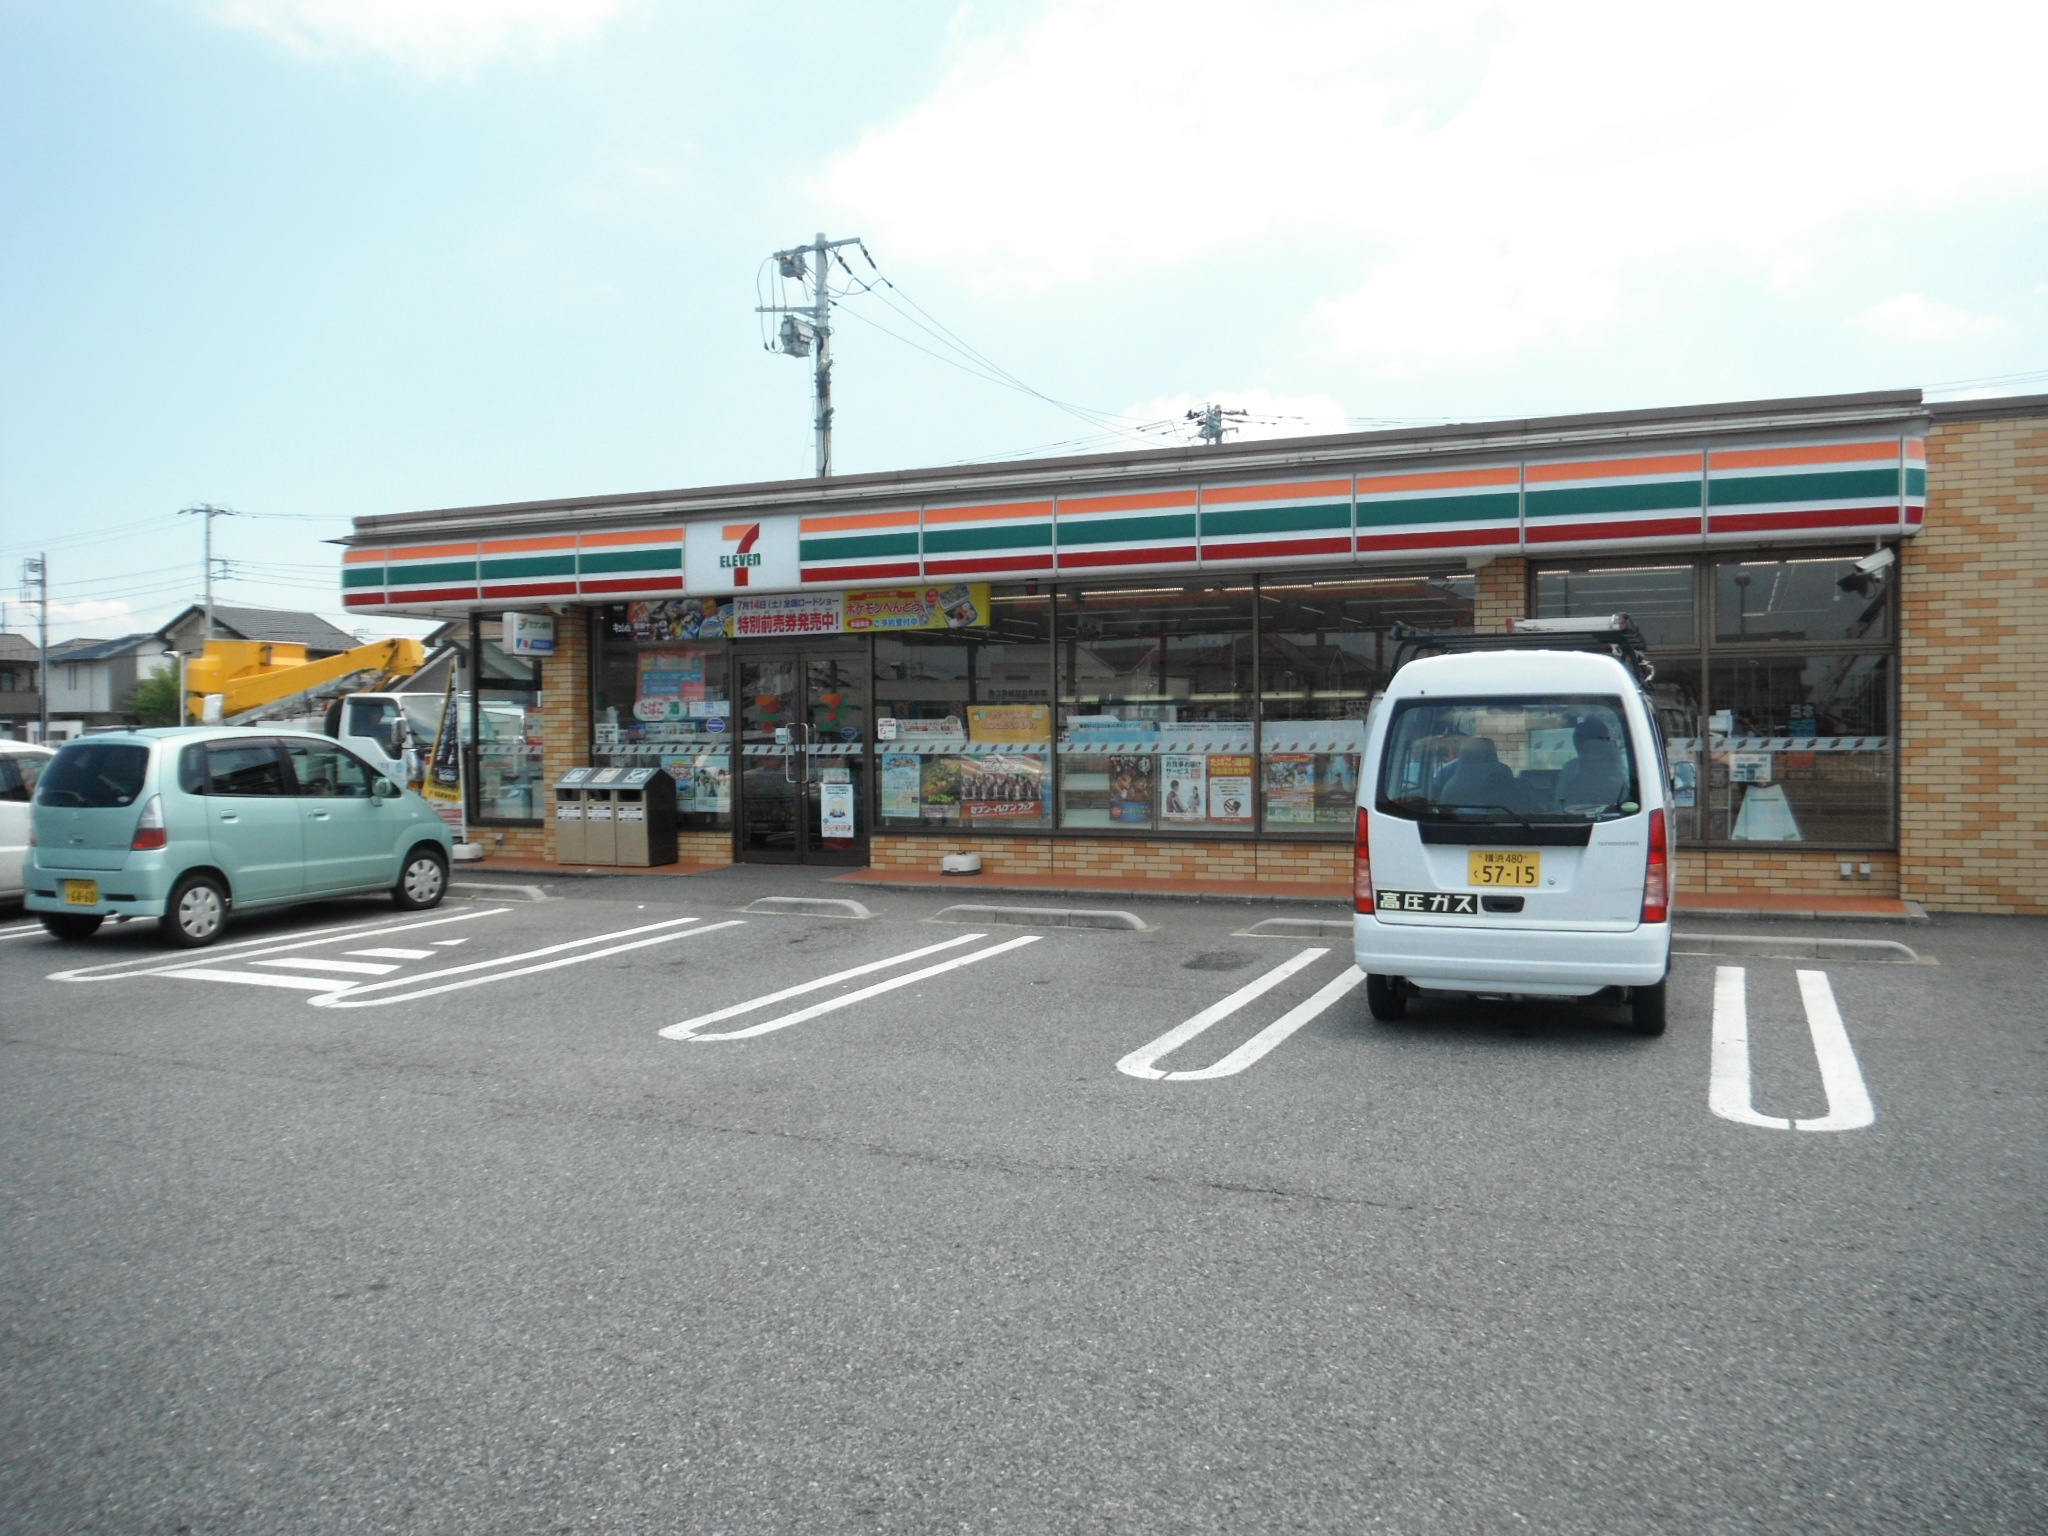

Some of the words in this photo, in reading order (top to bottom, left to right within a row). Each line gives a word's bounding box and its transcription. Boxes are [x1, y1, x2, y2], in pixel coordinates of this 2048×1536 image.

[722, 522, 760, 587] 7
[640, 701, 665, 715] たばこ
[1485, 853, 1504, 863] 横浜
[1505, 854, 1523, 863] 480
[1482, 865, 1535, 884] 57-15
[1379, 892, 1473, 913] 高圧ガス
